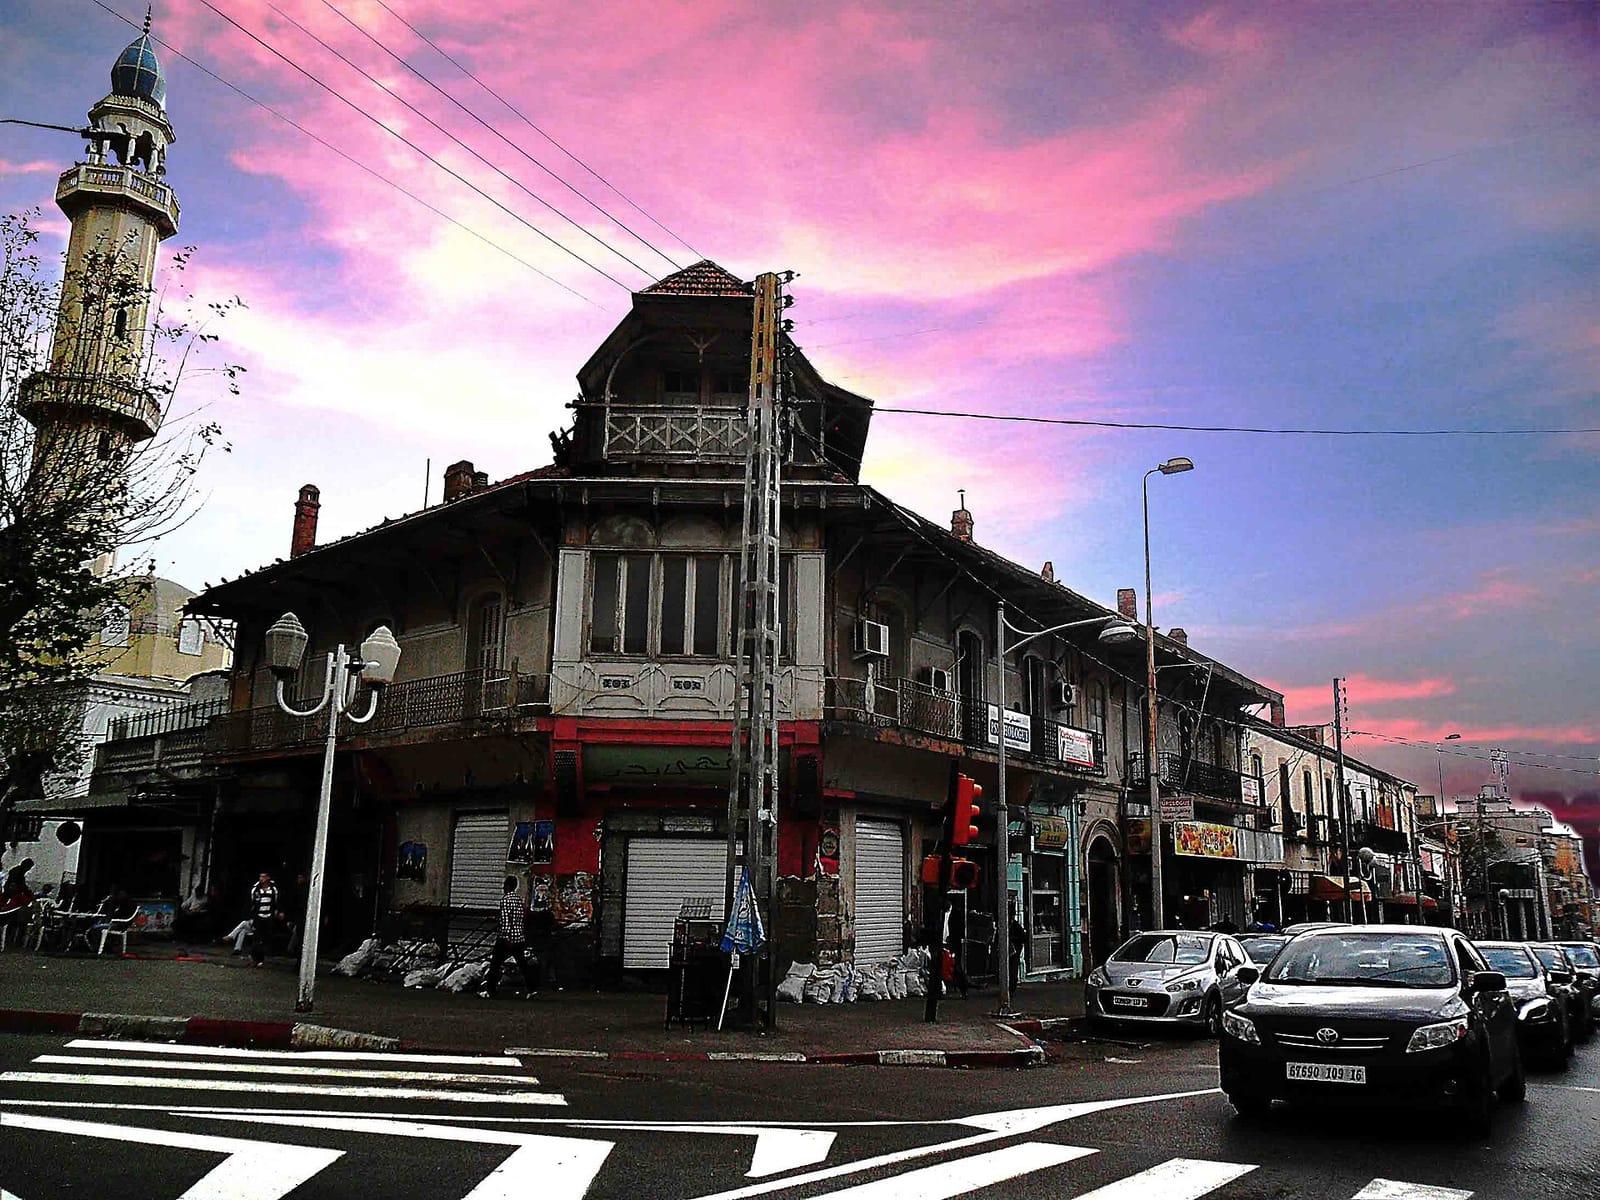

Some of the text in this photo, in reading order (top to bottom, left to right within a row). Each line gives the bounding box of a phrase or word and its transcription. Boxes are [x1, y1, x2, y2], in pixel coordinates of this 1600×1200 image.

[991, 721, 1028, 742] PSYHOLOGUE
[1289, 1065, 1362, 1081] 67690 109 16
